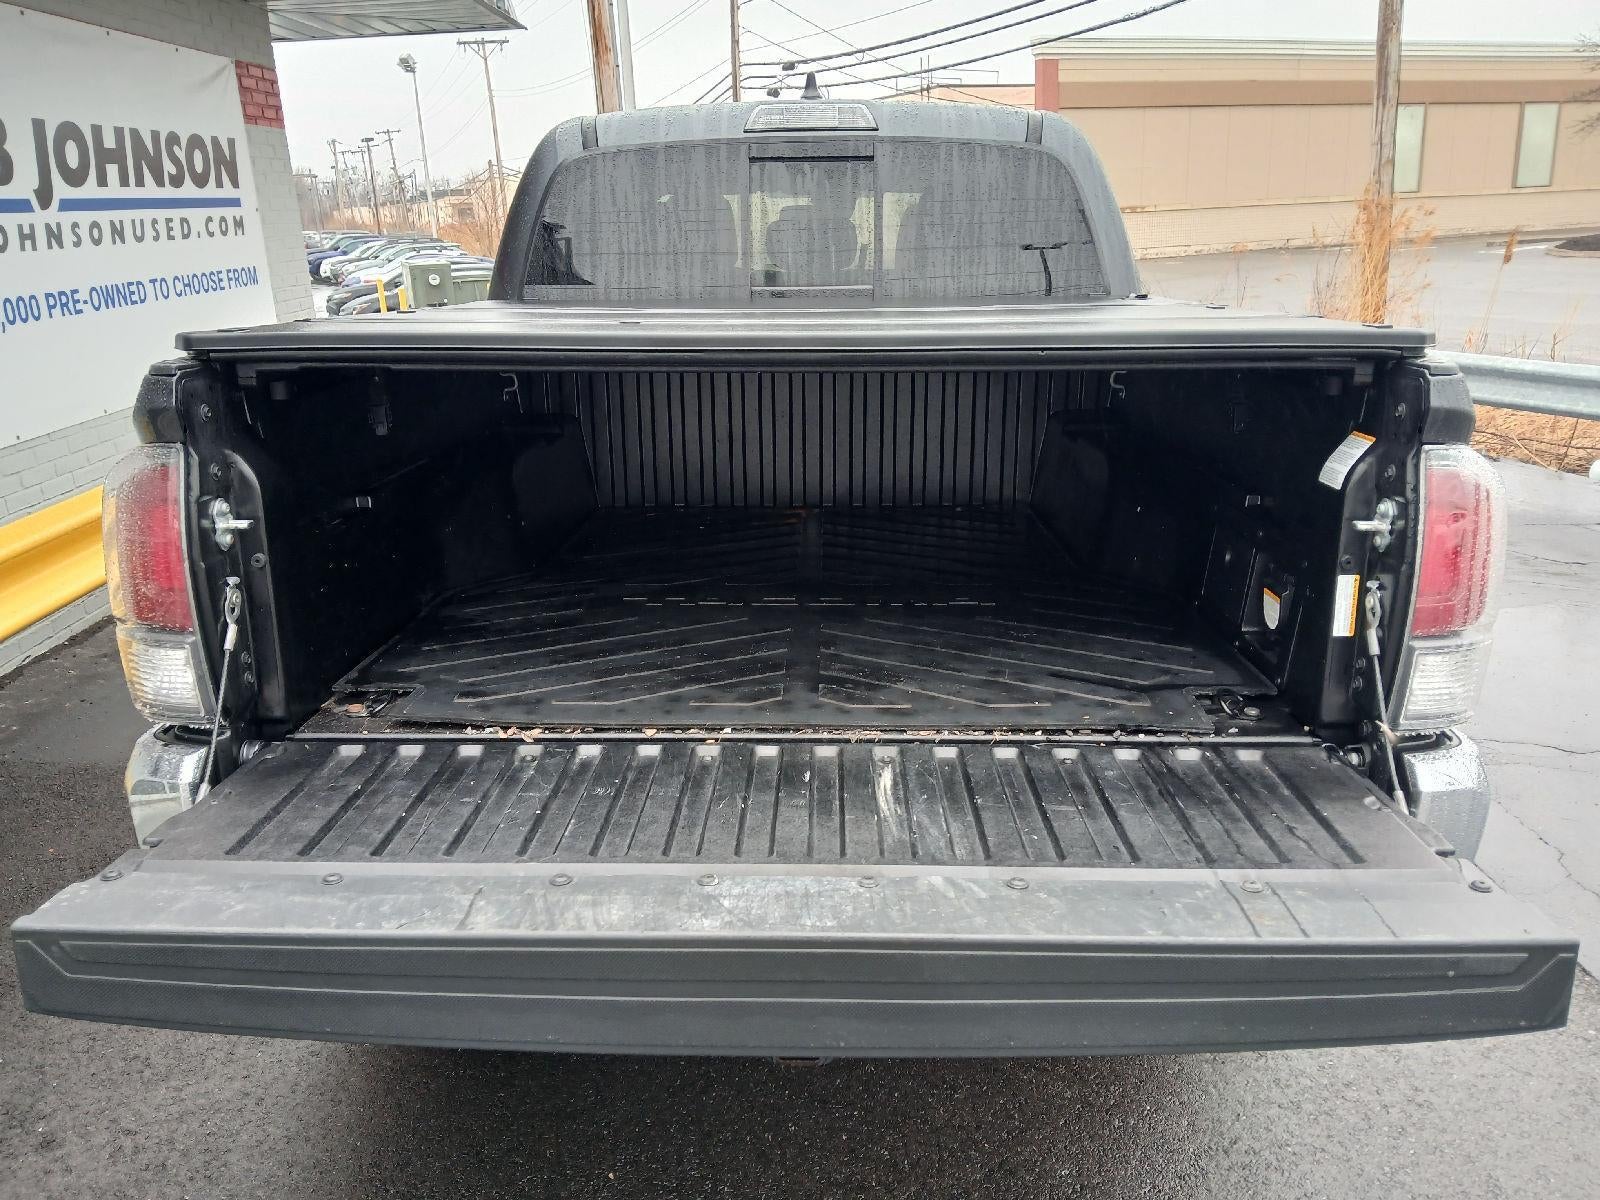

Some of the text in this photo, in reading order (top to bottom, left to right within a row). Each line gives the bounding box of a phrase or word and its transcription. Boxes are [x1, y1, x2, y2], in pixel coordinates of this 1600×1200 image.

[31, 118, 240, 210] JOHNSON
[44, 280, 147, 318] PRE-OWNED
[149, 276, 170, 301] TO
[173, 270, 225, 297] CHOOSE
[228, 266, 259, 290] FROM
